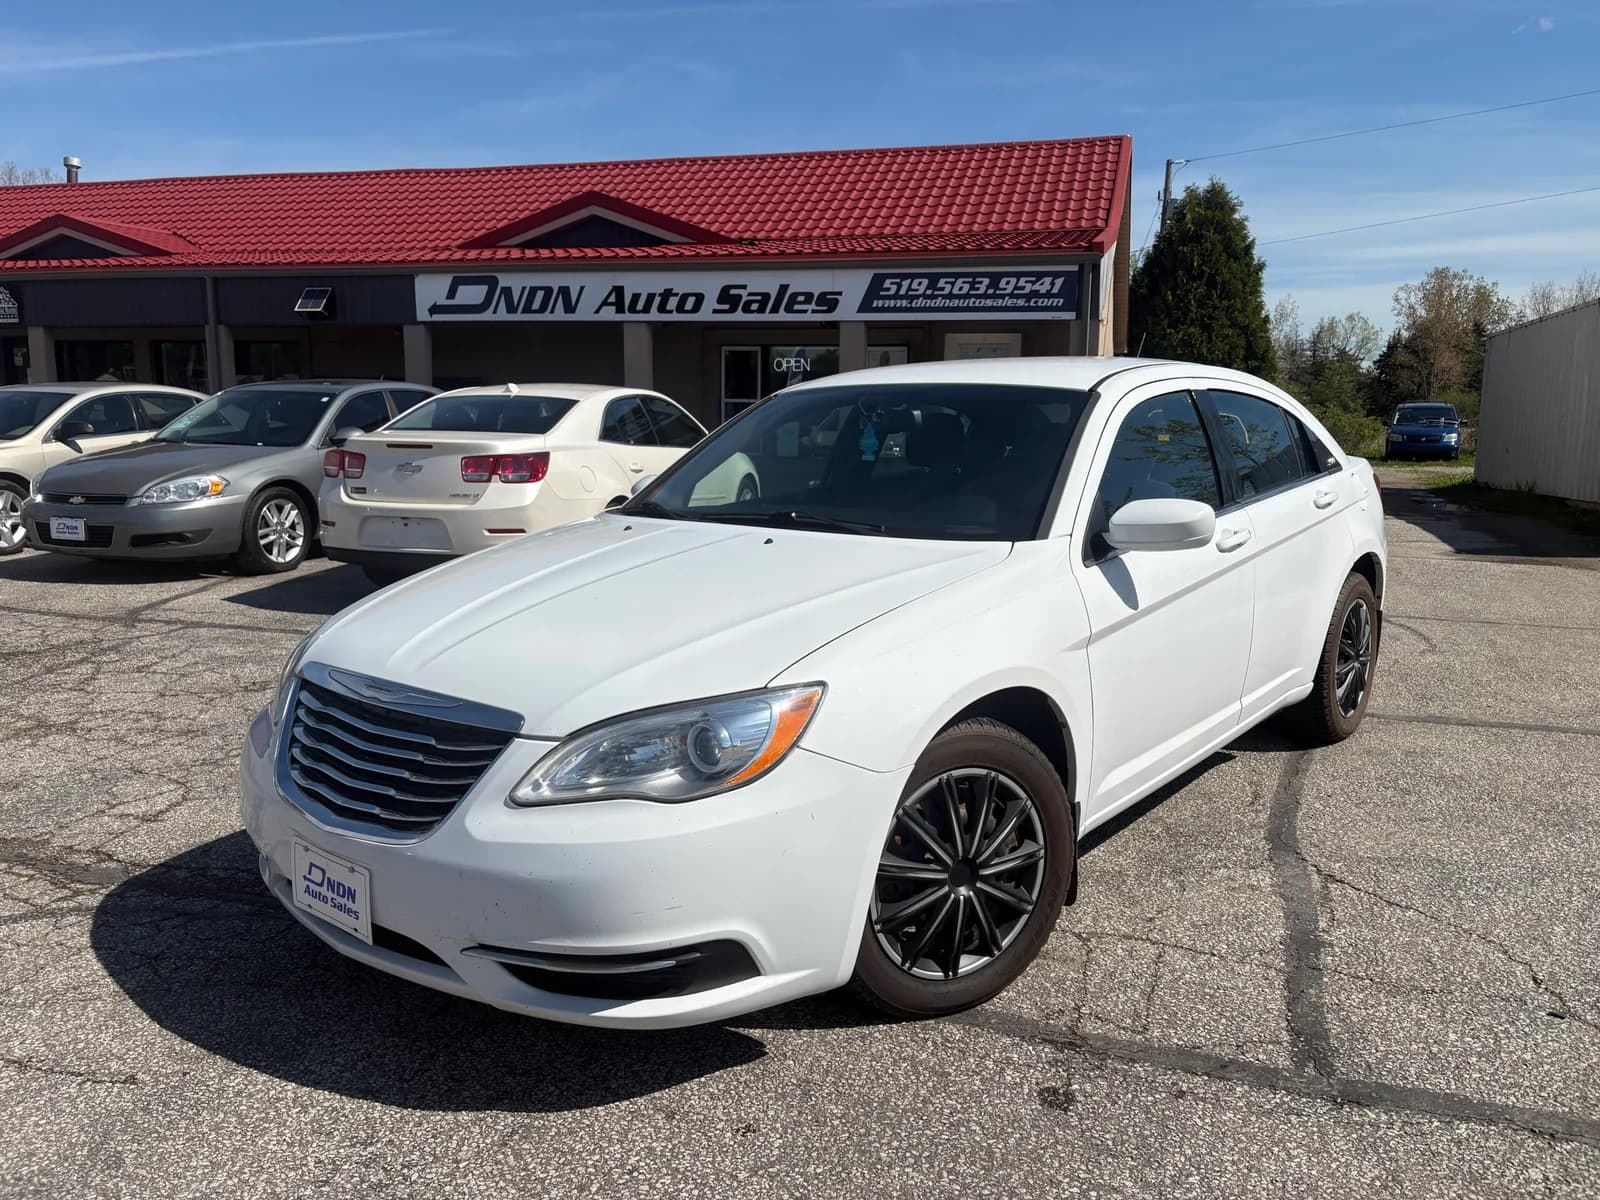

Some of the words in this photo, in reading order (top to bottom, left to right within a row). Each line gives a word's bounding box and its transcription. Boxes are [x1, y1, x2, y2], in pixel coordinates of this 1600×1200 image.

[880, 277, 1065, 295] 519.563.9541
[594, 285, 704, 315] Auto
[711, 283, 843, 315] Sales
[872, 296, 1064, 308] www.dndnautosales.com
[773, 358, 811, 372] OPEN
[304, 884, 329, 905] Auto
[330, 897, 360, 921] Sales
